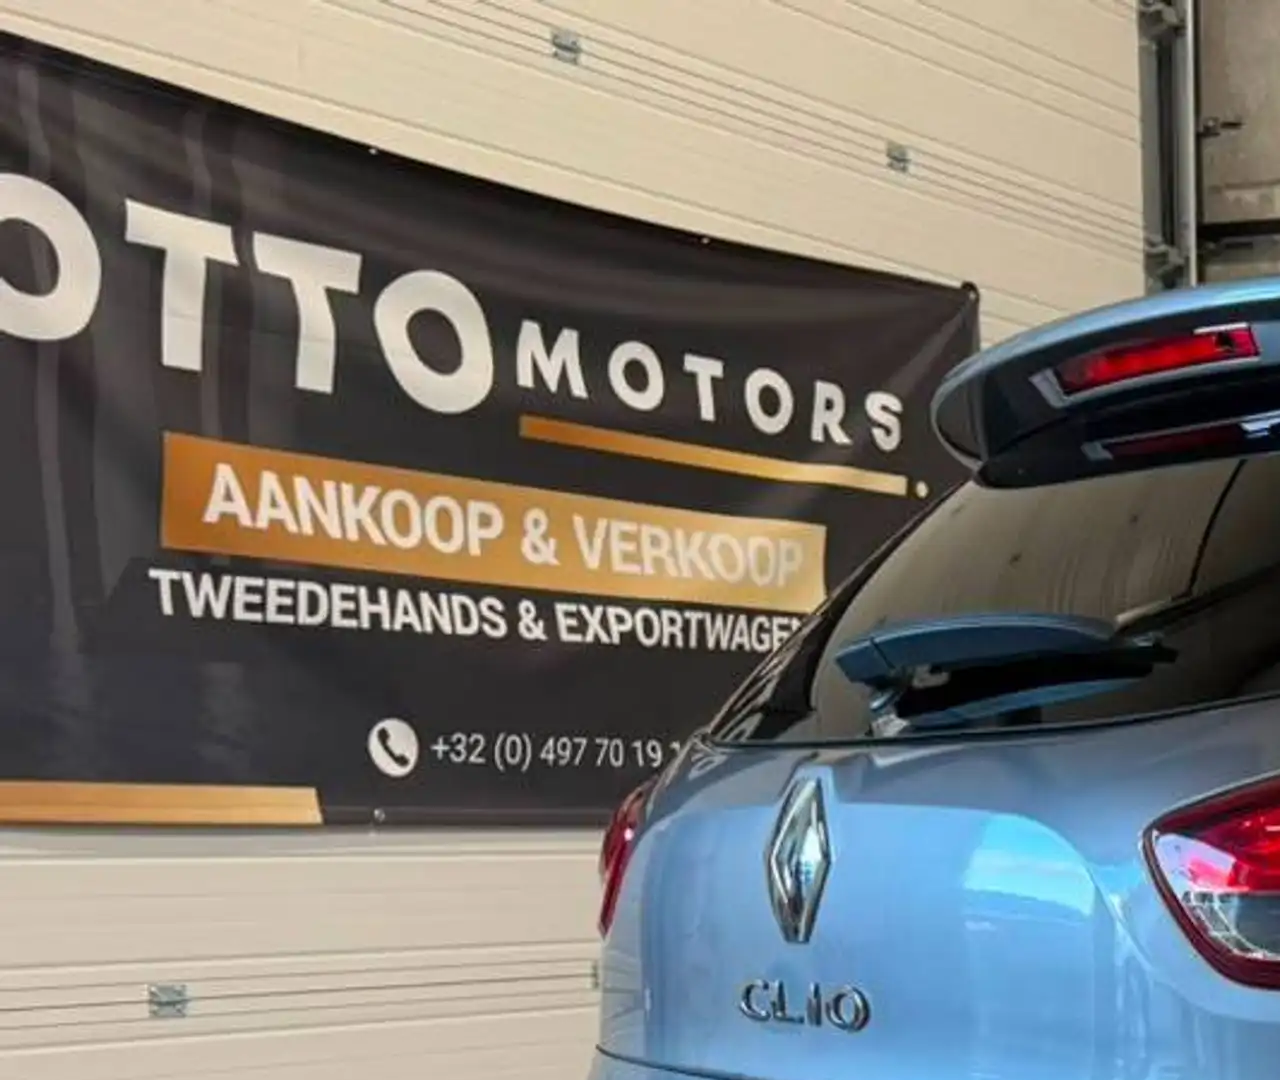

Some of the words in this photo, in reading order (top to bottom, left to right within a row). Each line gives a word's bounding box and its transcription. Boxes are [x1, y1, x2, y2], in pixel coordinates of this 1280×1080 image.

[0, 171, 494, 414] OTTO
[515, 319, 904, 452] MOTORS
[201, 462, 504, 557] AANKOOP
[520, 508, 560, 565] &
[572, 513, 804, 588] VERKOOP
[148, 567, 507, 640] TWEEDEHANDS
[518, 599, 548, 642] &
[556, 602, 802, 654] EXPORTWAGE
[430, 732, 486, 764] +32
[494, 732, 532, 772] (0)
[540, 737, 587, 766] 497
[595, 738, 624, 767] 70
[631, 740, 663, 768] 19
[737, 978, 871, 1033] CLIO
